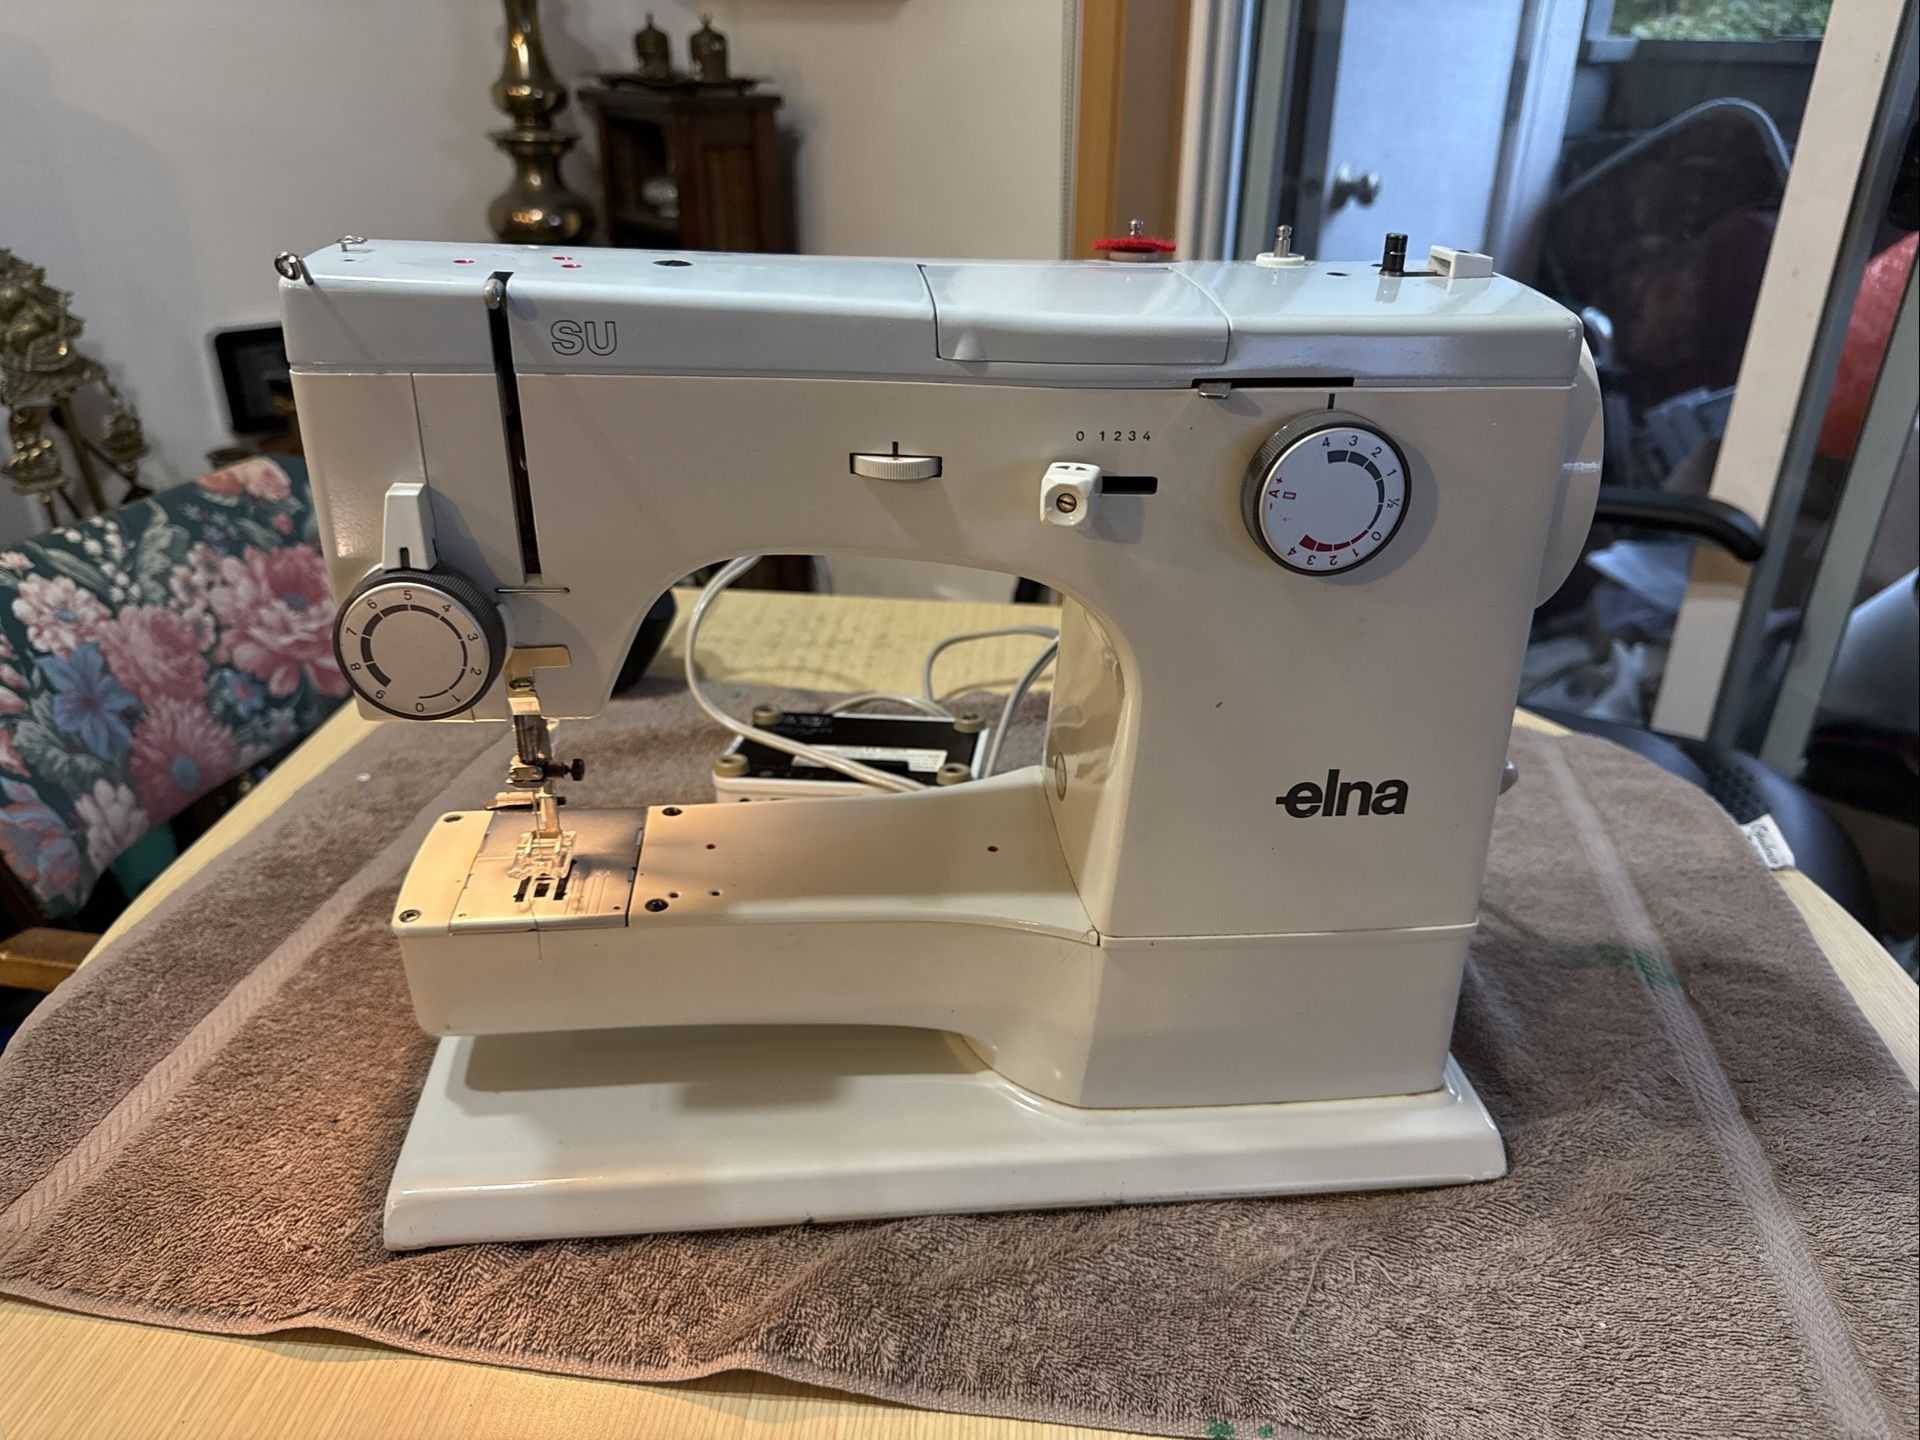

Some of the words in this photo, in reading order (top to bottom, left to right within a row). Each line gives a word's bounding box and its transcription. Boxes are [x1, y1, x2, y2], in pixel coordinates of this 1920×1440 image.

[550, 319, 618, 357] SU
[1075, 430, 1085, 442] 0
[1098, 430, 1106, 442] 1
[1113, 430, 1122, 442] 2
[1127, 430, 1137, 442] 3
[1142, 430, 1152, 442] 4
[1321, 436, 1331, 448] 4
[1348, 435, 1359, 447] 3
[1370, 446, 1383, 459] 2
[1386, 468, 1398, 477] 1
[1268, 488, 1281, 499] A
[1287, 546, 1298, 557] 4
[1351, 548, 1360, 558] 1
[1306, 554, 1317, 566] 3
[1329, 554, 1338, 566] 2
[403, 590, 413, 601] 5
[366, 599, 378, 610] 6
[441, 604, 452, 613] 4
[345, 626, 358, 636] 7
[467, 632, 480, 642] 3
[350, 662, 362, 672] 8
[469, 667, 483, 676] 2
[375, 689, 387, 700] 9
[451, 694, 462, 703] 1
[415, 703, 425, 713] 0
[1275, 768, 1409, 819] elna
